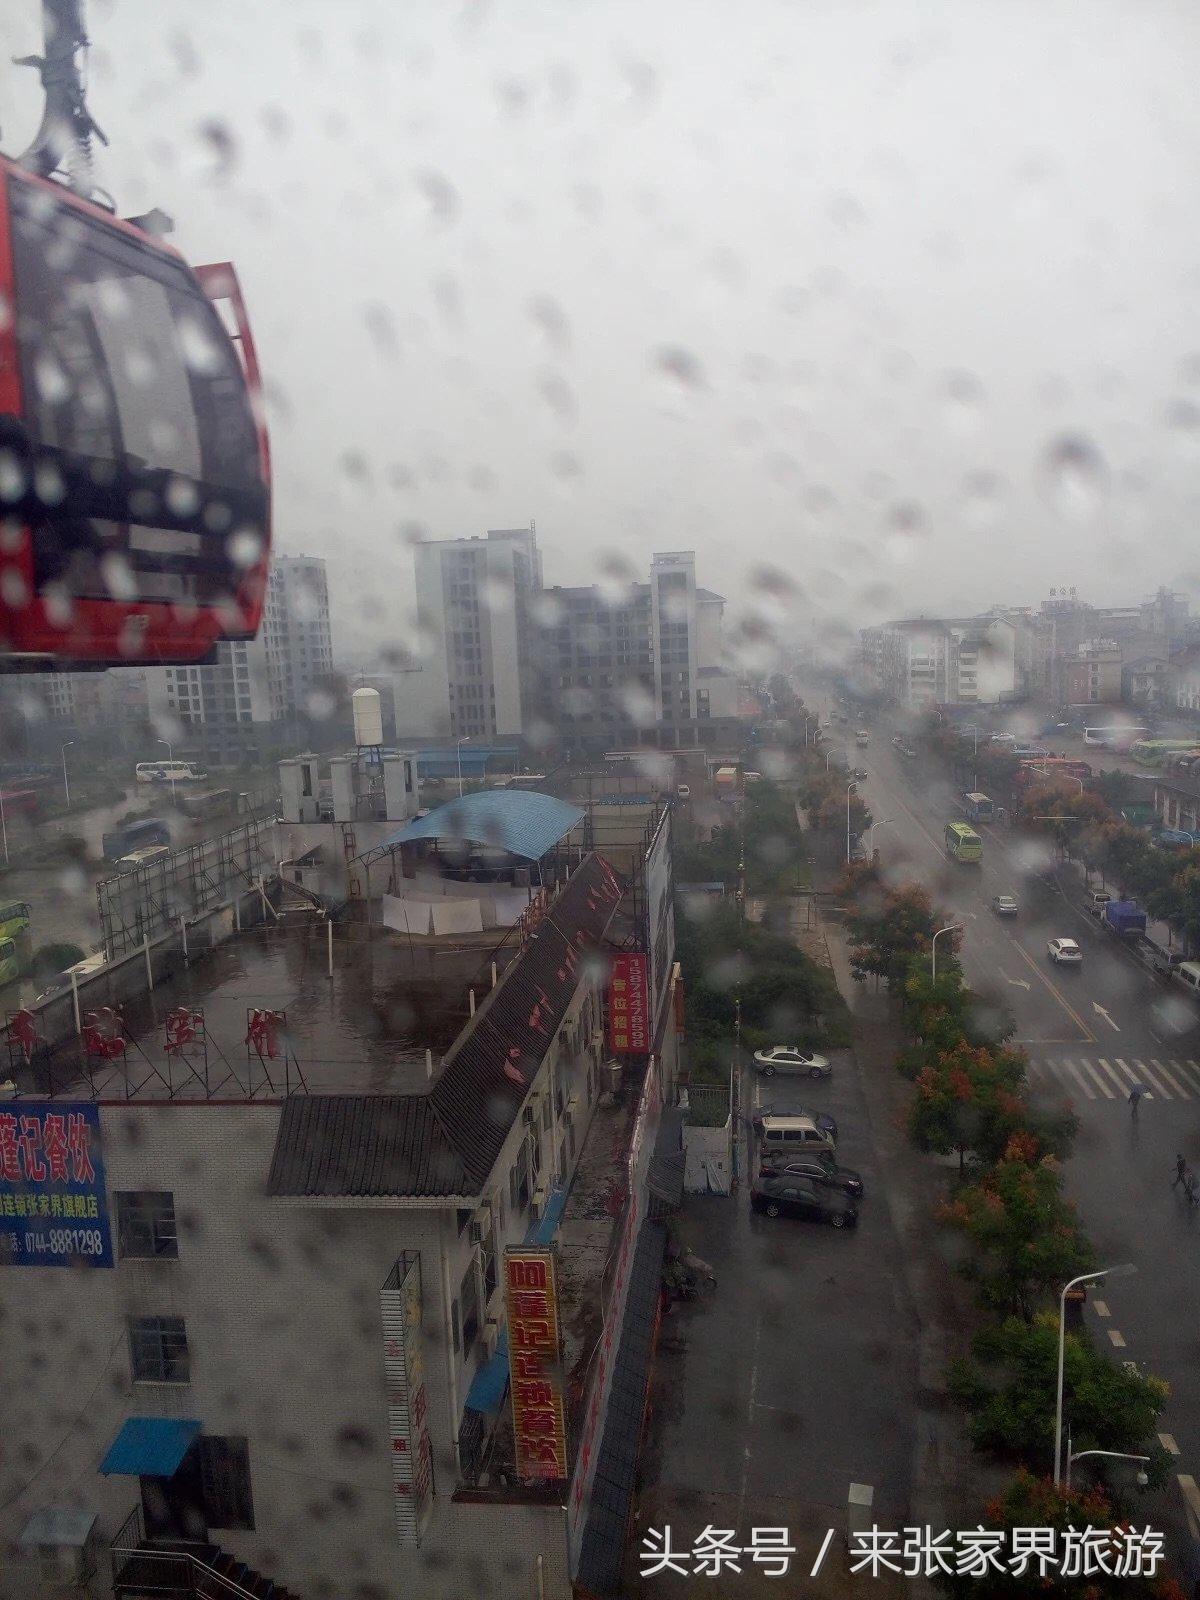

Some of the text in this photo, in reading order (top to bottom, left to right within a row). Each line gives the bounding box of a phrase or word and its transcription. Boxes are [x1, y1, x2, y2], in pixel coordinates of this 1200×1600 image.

[0, 1193, 99, 1219] 连锁张家界旗舰店
[25, 1228, 103, 1255] 0744-8881298
